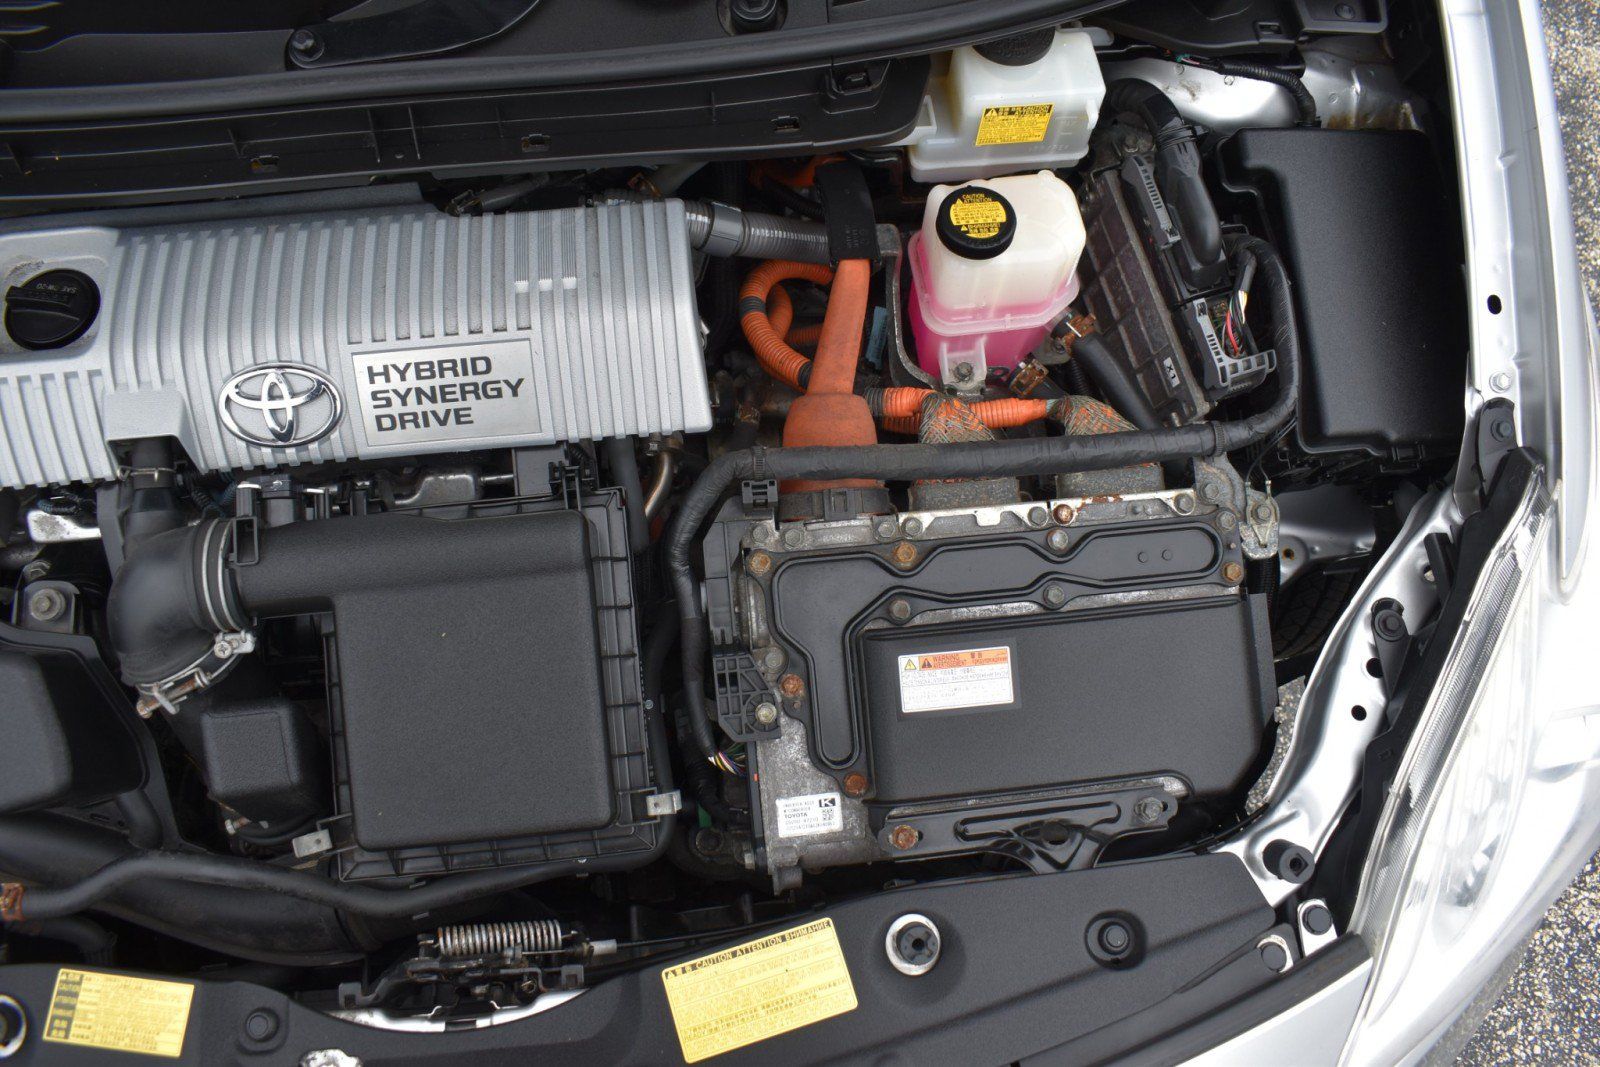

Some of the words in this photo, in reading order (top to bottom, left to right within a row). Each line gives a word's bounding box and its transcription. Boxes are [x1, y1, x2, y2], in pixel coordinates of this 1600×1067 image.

[367, 356, 493, 385] HYBRID
[370, 377, 525, 409] SYNERGY
[375, 407, 475, 432] DRIVE
[933, 653, 960, 663] WARNING
[696, 949, 733, 969] CAUTION
[737, 936, 783, 957] ATTENTION
